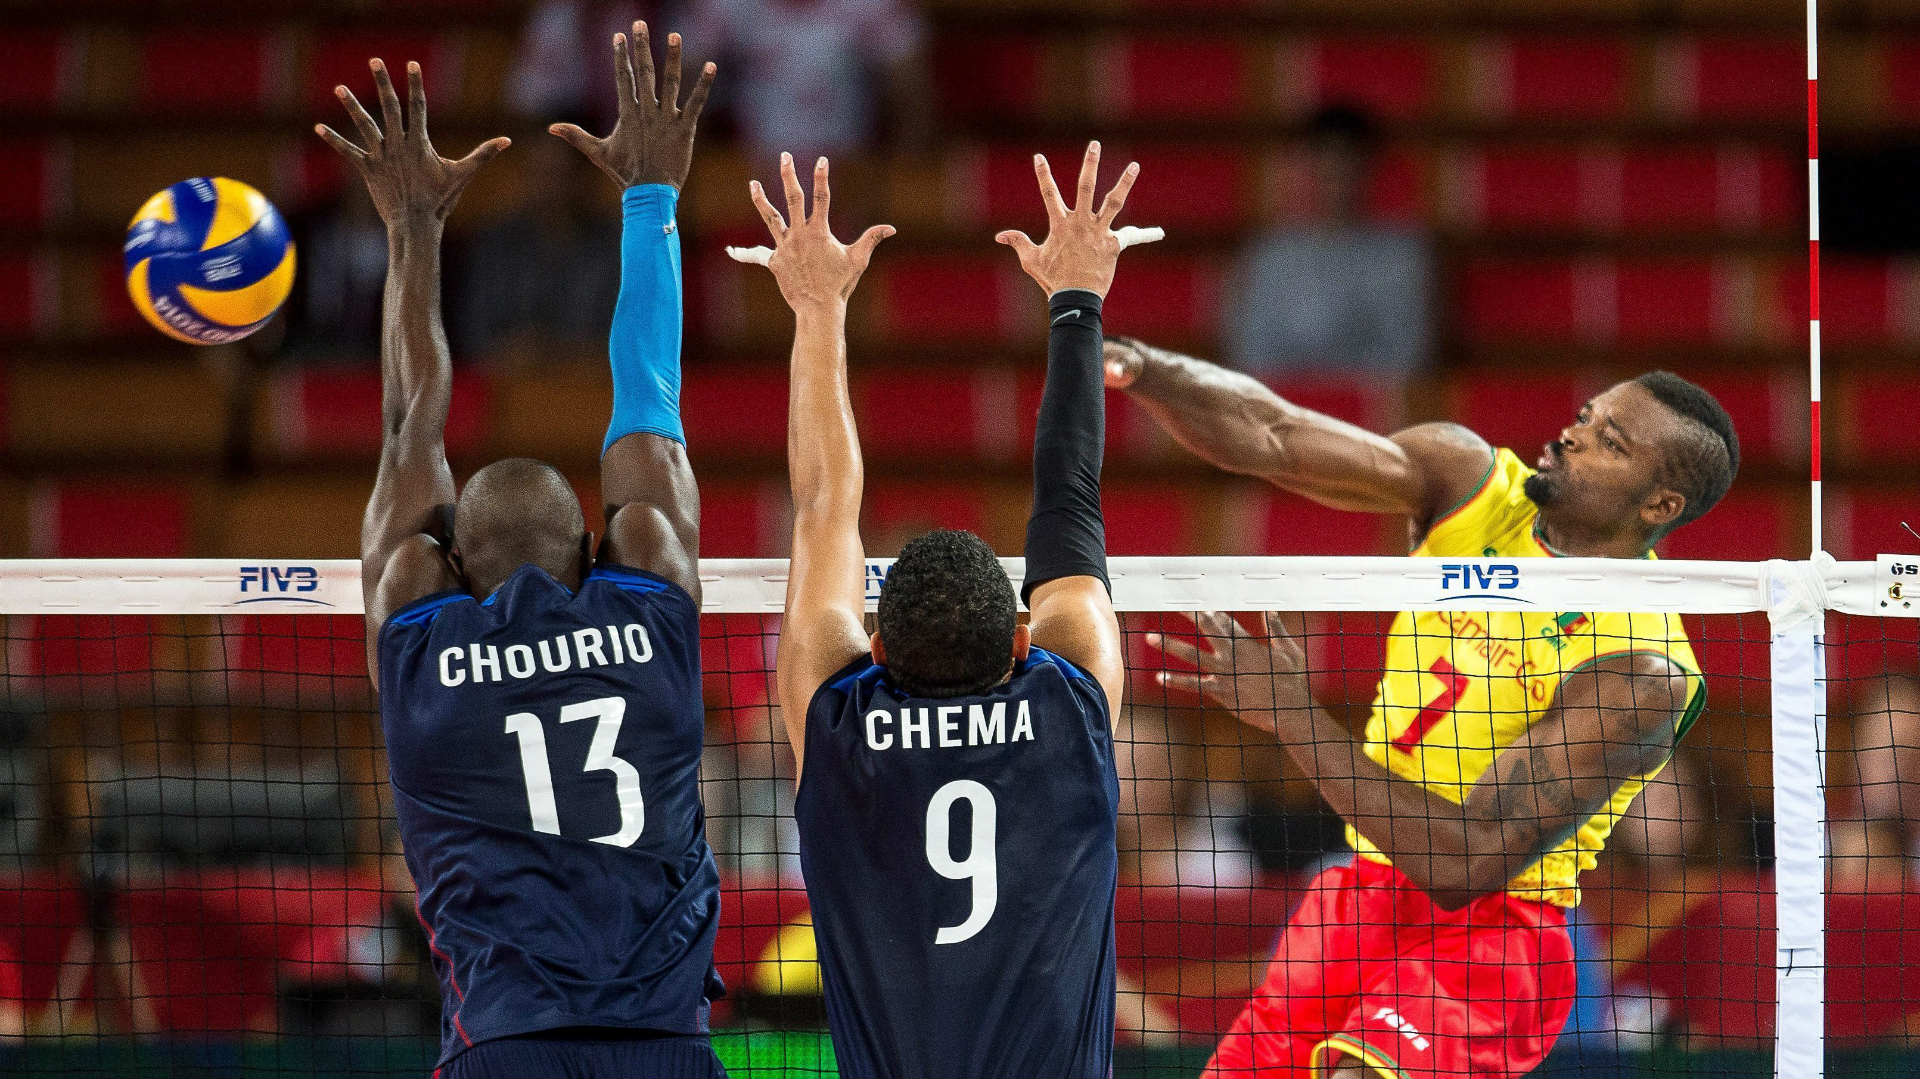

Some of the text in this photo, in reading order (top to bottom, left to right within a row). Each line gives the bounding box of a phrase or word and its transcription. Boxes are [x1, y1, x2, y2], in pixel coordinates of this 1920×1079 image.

[240, 566, 318, 592] FIVB
[865, 565, 894, 590] IV
[1442, 564, 1520, 589] FIVB
[438, 623, 653, 687] CHOURIO
[865, 699, 1035, 751] CHEMA
[504, 696, 645, 849] 13
[925, 779, 998, 945] 9
